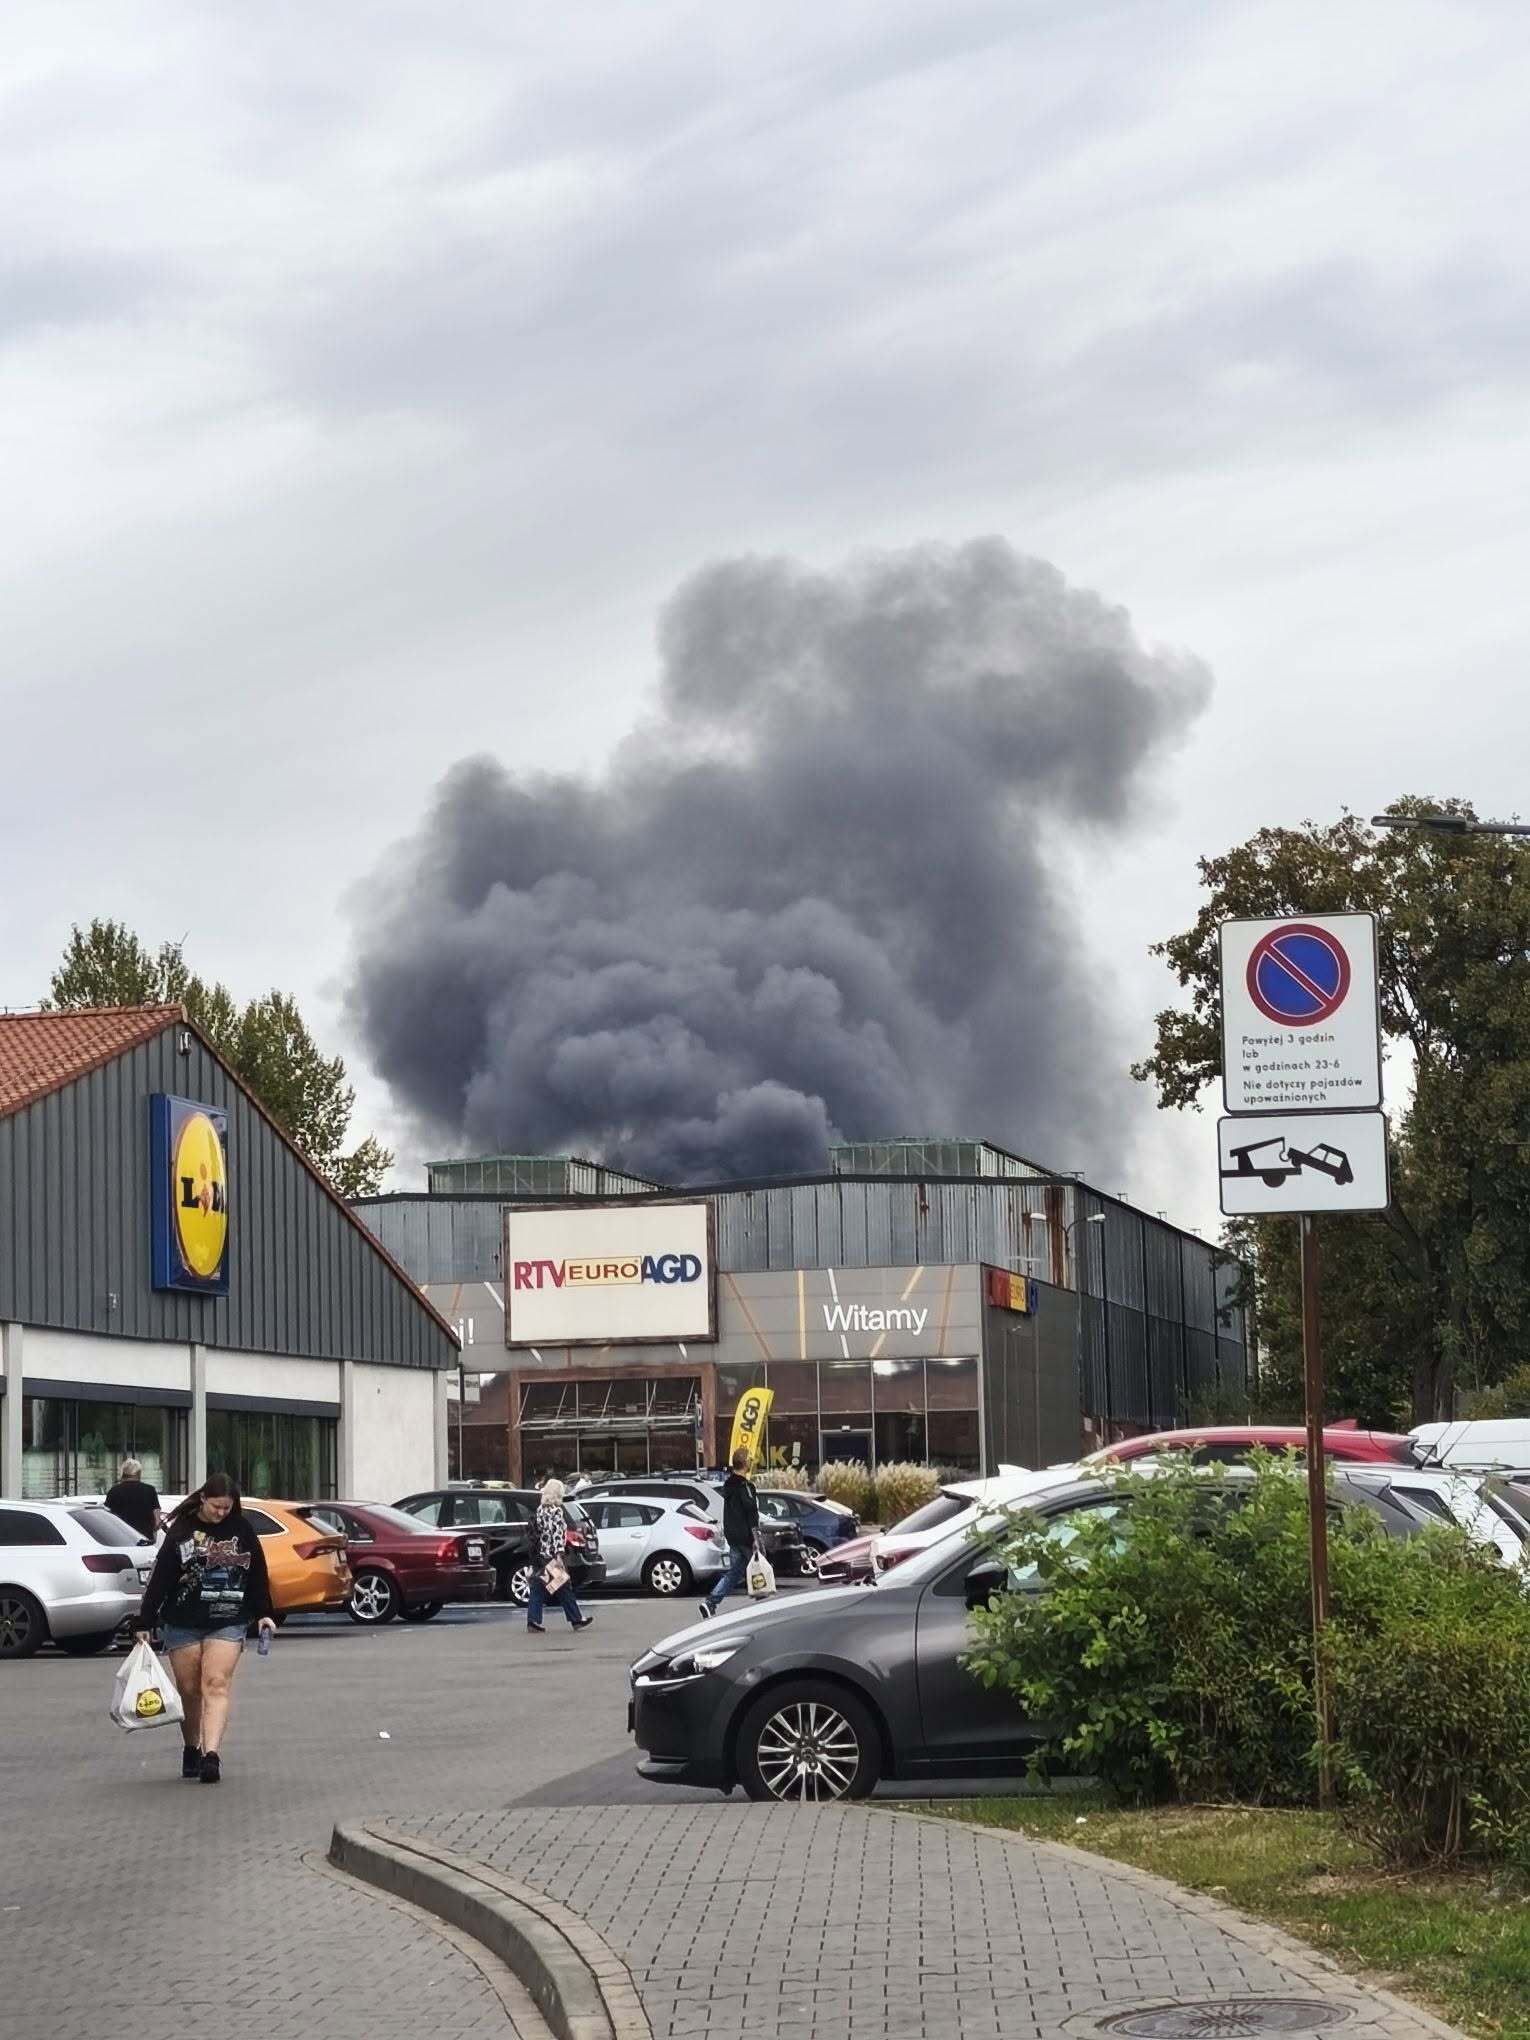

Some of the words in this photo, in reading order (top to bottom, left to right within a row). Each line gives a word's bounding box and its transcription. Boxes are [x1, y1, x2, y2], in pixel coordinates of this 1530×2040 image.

[1242, 1035, 1284, 1046] Powyżej
[1287, 1034, 1294, 1043] 3
[1298, 1033, 1335, 1045] godzin
[1242, 1049, 1259, 1059] lub
[1255, 1061, 1311, 1073] godzinach
[1315, 1060, 1340, 1070] 23-6
[1243, 1080, 1262, 1090] Nie
[1266, 1080, 1306, 1090] dotyczy
[1310, 1077, 1362, 1089] pojazdów
[1244, 1092, 1326, 1105] upoważnionych
[514, 1260, 566, 1290] RTV
[569, 1263, 639, 1280] EURO
[641, 1254, 702, 1284] AGD
[823, 1304, 928, 1335] Witamy
[740, 1397, 760, 1432] AGD
